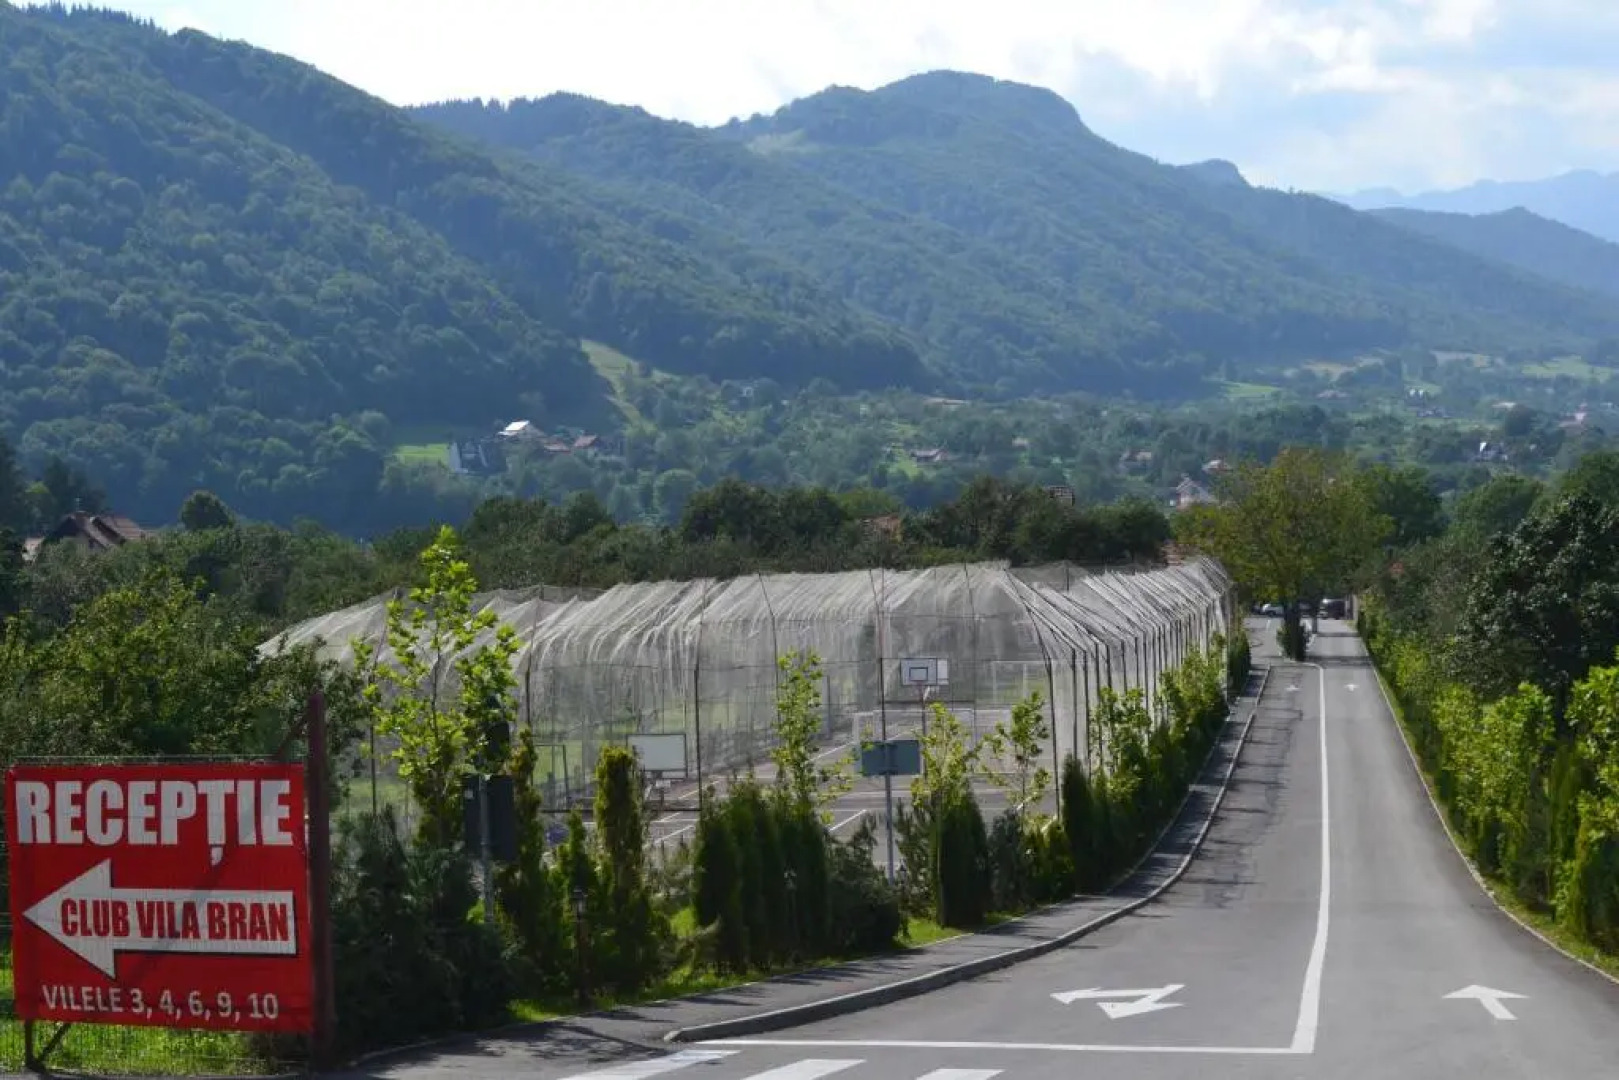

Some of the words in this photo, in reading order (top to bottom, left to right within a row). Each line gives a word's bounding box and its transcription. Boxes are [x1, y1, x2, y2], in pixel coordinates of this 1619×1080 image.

[61, 898, 130, 937] CLUB
[136, 900, 200, 940] VILA
[207, 901, 289, 941] BRAN
[42, 984, 124, 1013] VILELE
[130, 988, 153, 1019] 3,
[159, 990, 182, 1020] 4,
[188, 990, 211, 1021] 6,
[217, 991, 240, 1022] 9,
[249, 993, 279, 1019] 10
